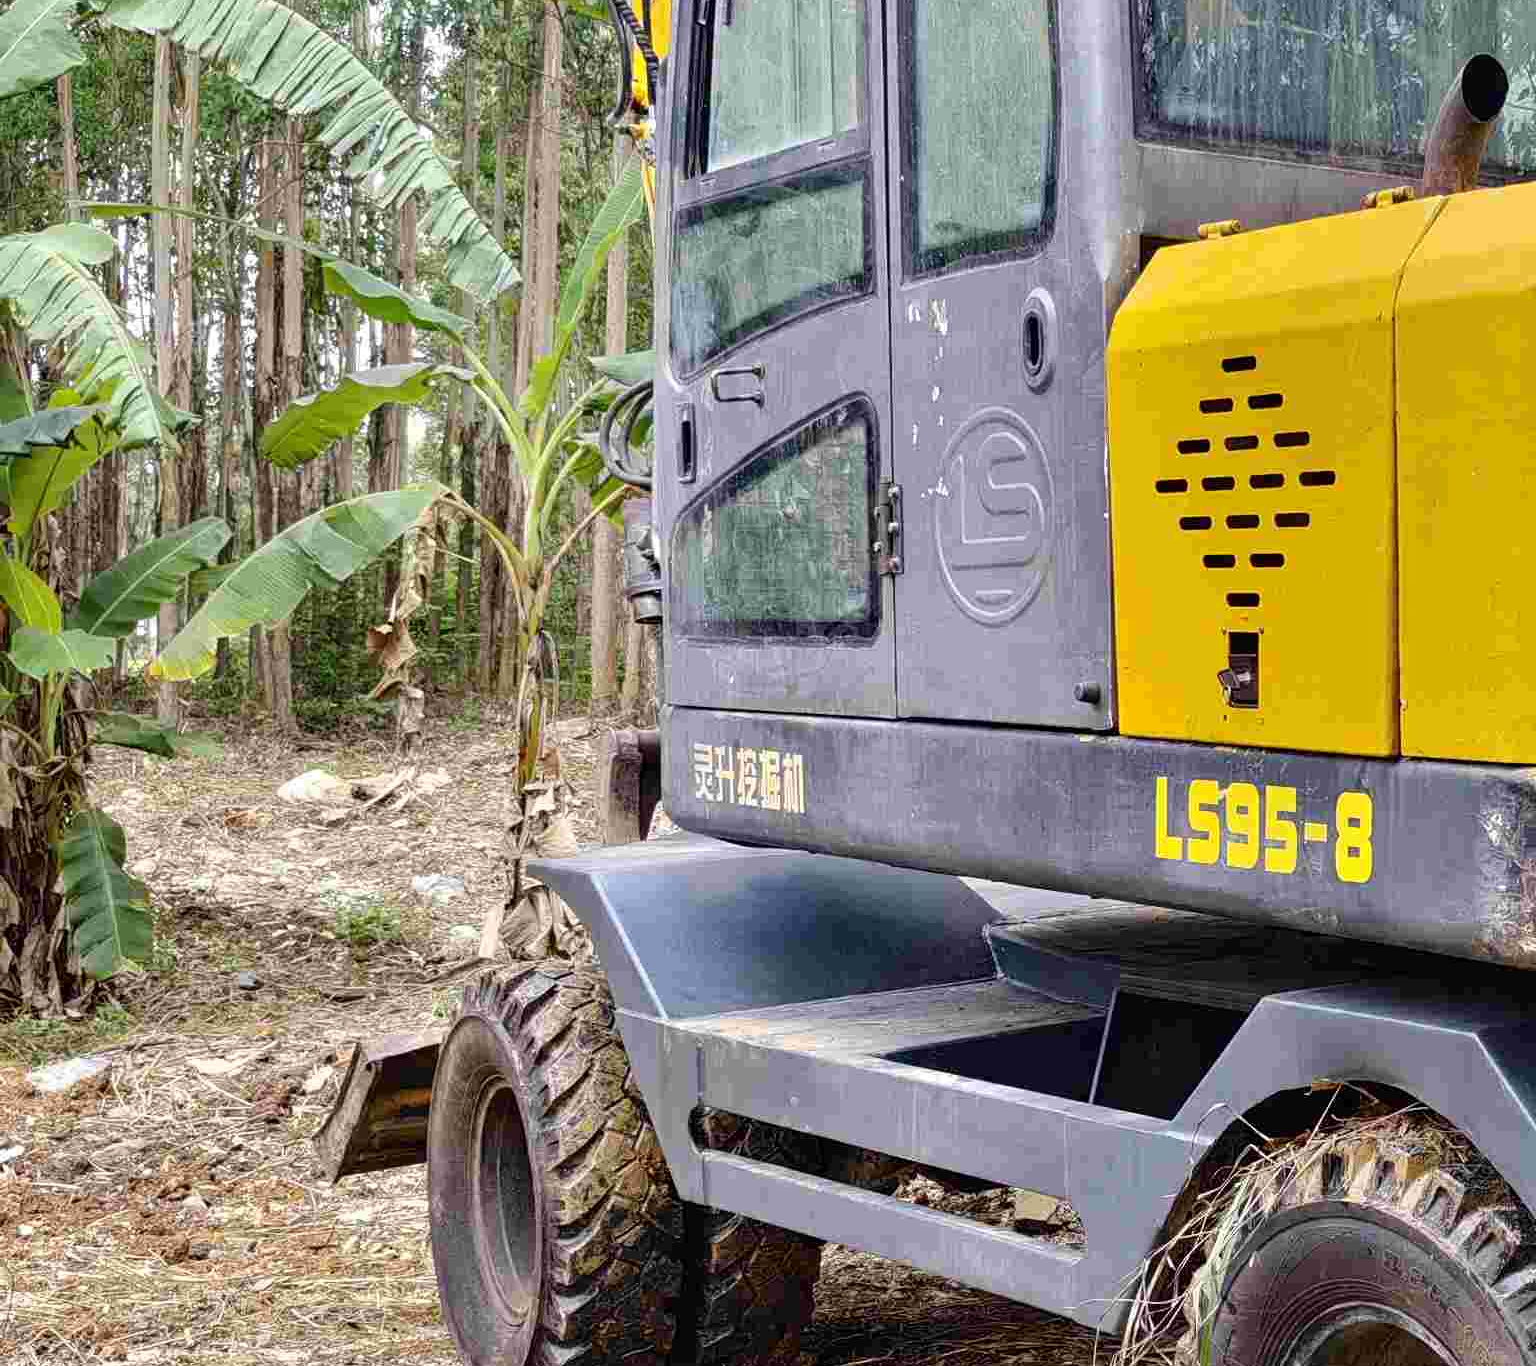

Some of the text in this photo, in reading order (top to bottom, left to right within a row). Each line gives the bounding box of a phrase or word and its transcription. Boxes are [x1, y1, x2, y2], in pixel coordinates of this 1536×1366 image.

[694, 742, 805, 814] 灵升挖掘机
[1155, 776, 1374, 883] LS95-8
